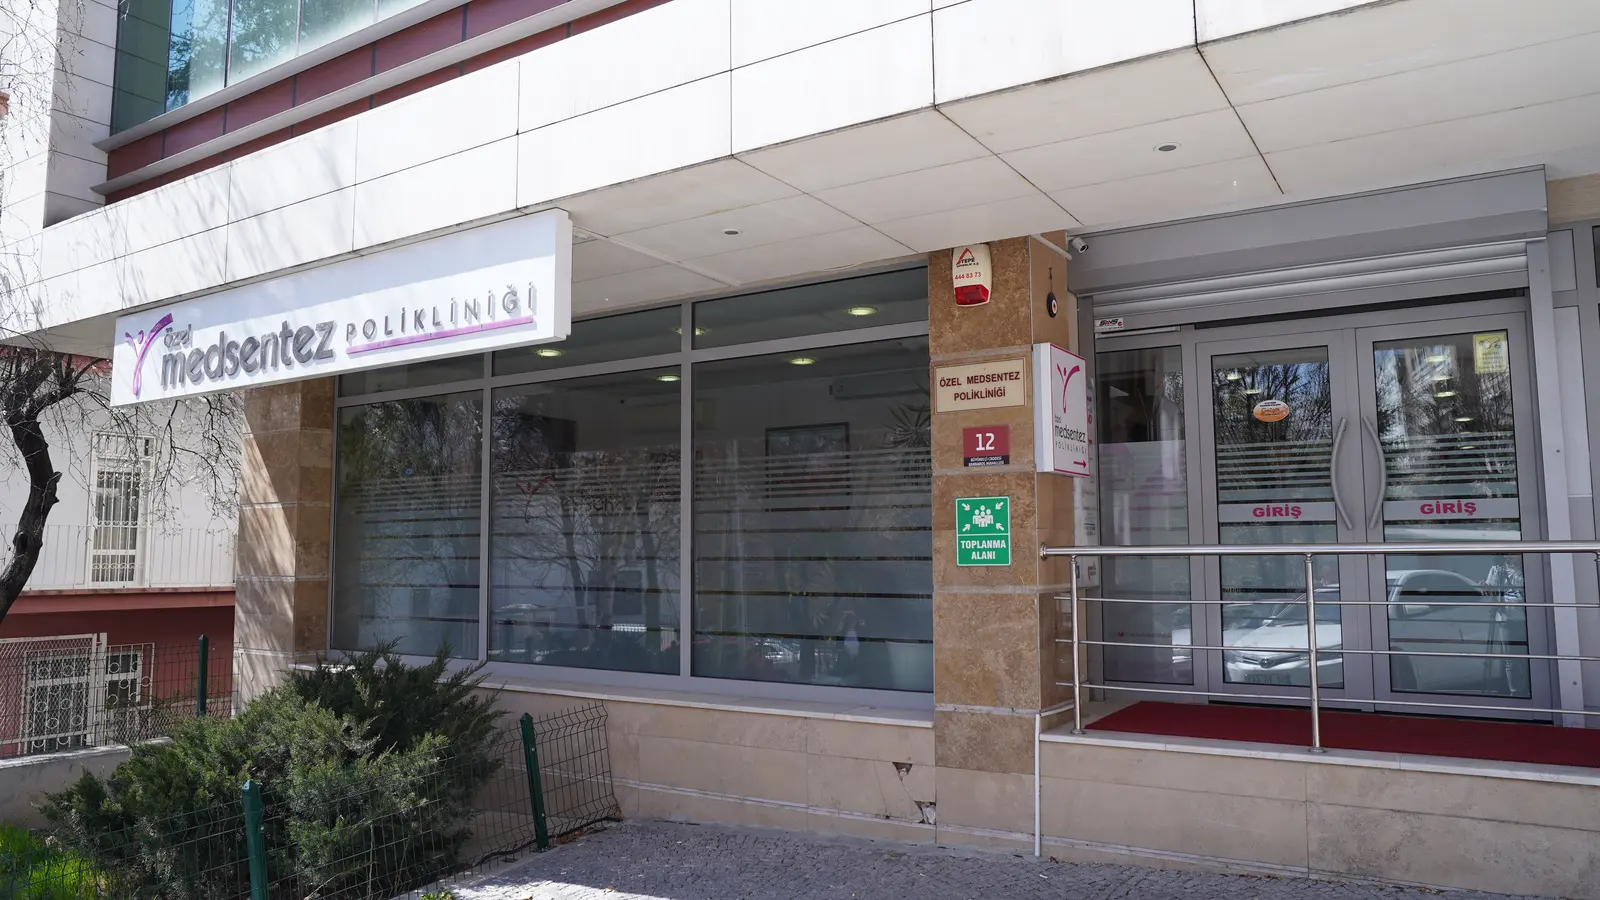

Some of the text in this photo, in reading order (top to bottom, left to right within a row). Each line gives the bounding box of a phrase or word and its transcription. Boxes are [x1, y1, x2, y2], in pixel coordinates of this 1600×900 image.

[346, 281, 534, 342] POLİKLİNİĞİ
[161, 320, 336, 390] medsentez
[939, 371, 1020, 388] ÖZEL MEDSENTEZ
[953, 386, 1006, 401] POLİKLİNİĞİ
[976, 432, 995, 451] 12
[1054, 424, 1086, 444] medsentez
[1252, 504, 1302, 519] GİRİŞ
[1420, 500, 1477, 516] GİRİŞ
[960, 539, 1006, 549] TOPLANMA
[971, 551, 996, 560] ALANI
